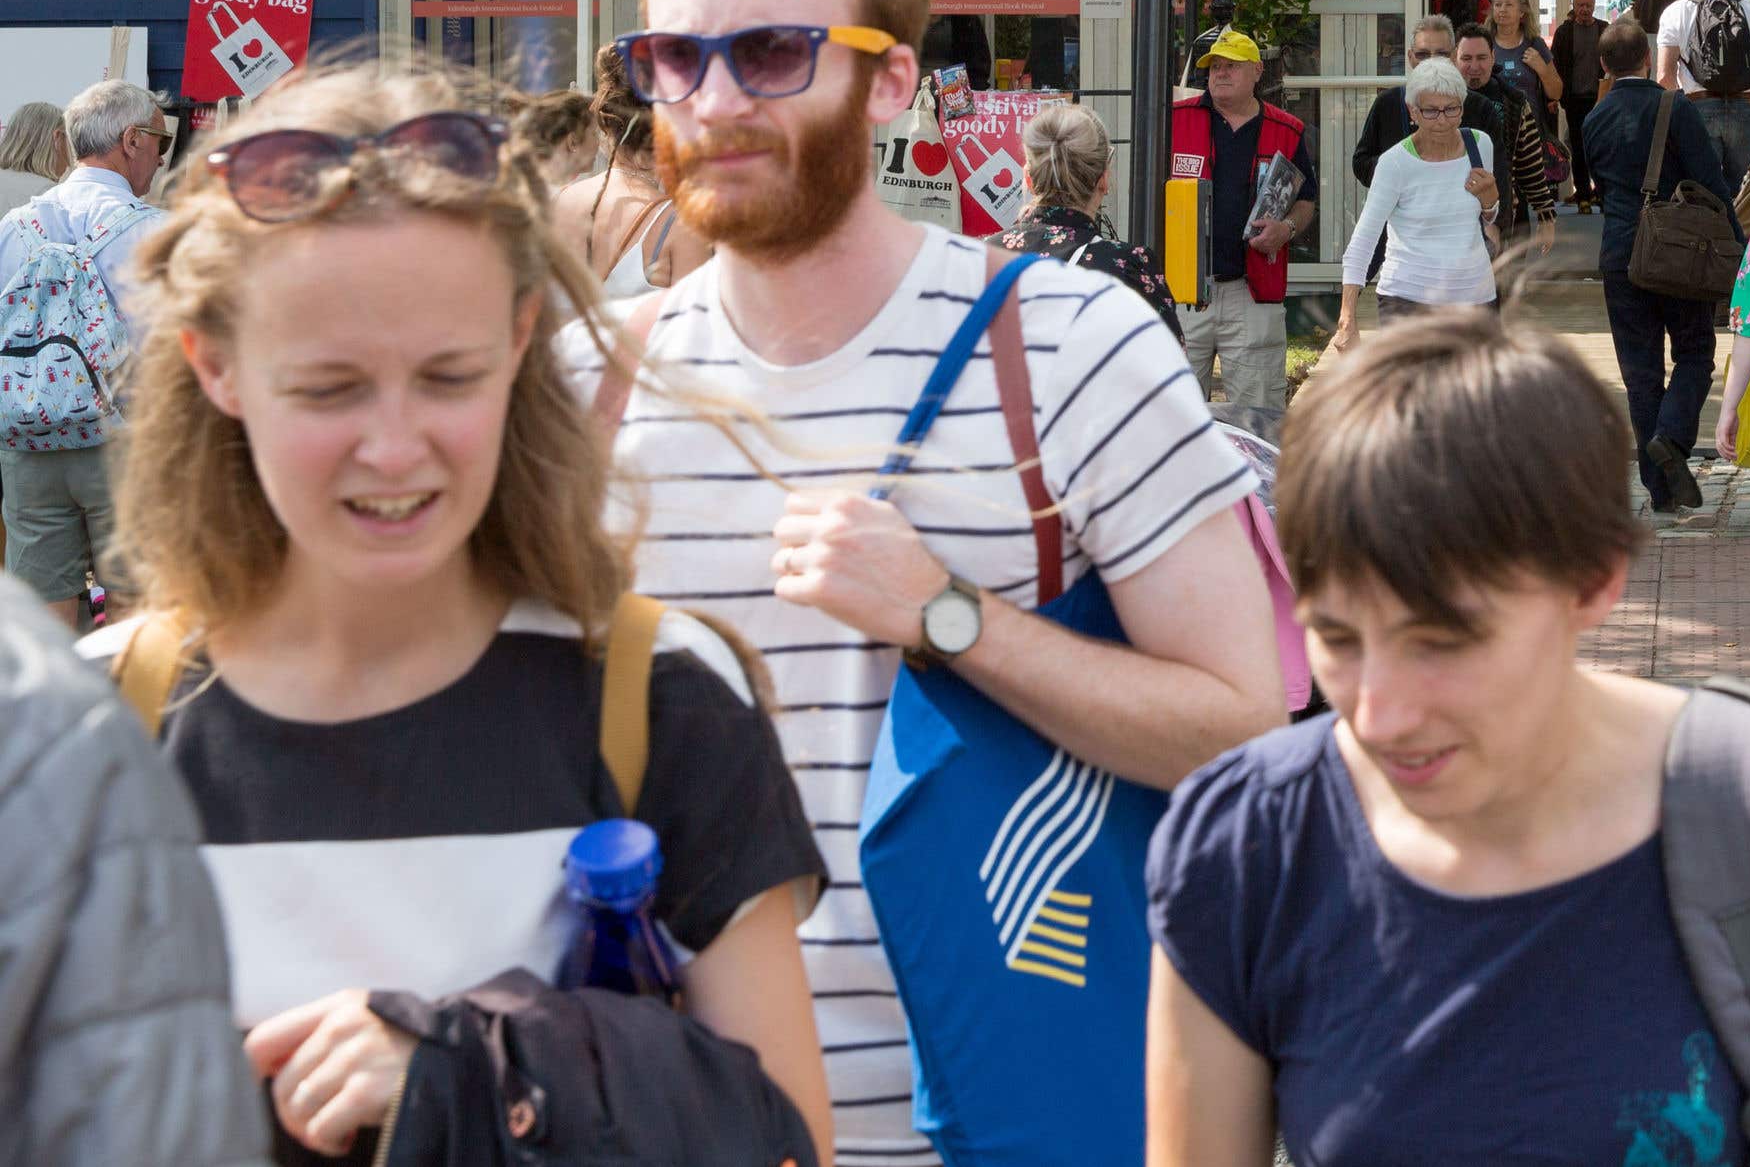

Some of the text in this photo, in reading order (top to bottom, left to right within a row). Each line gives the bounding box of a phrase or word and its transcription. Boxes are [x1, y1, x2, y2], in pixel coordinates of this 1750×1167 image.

[943, 115, 1011, 138] goody
[886, 137, 909, 174] I
[1176, 164, 1199, 173] ISSUE
[883, 176, 952, 192] EDINBURGH
[980, 182, 999, 204] I
